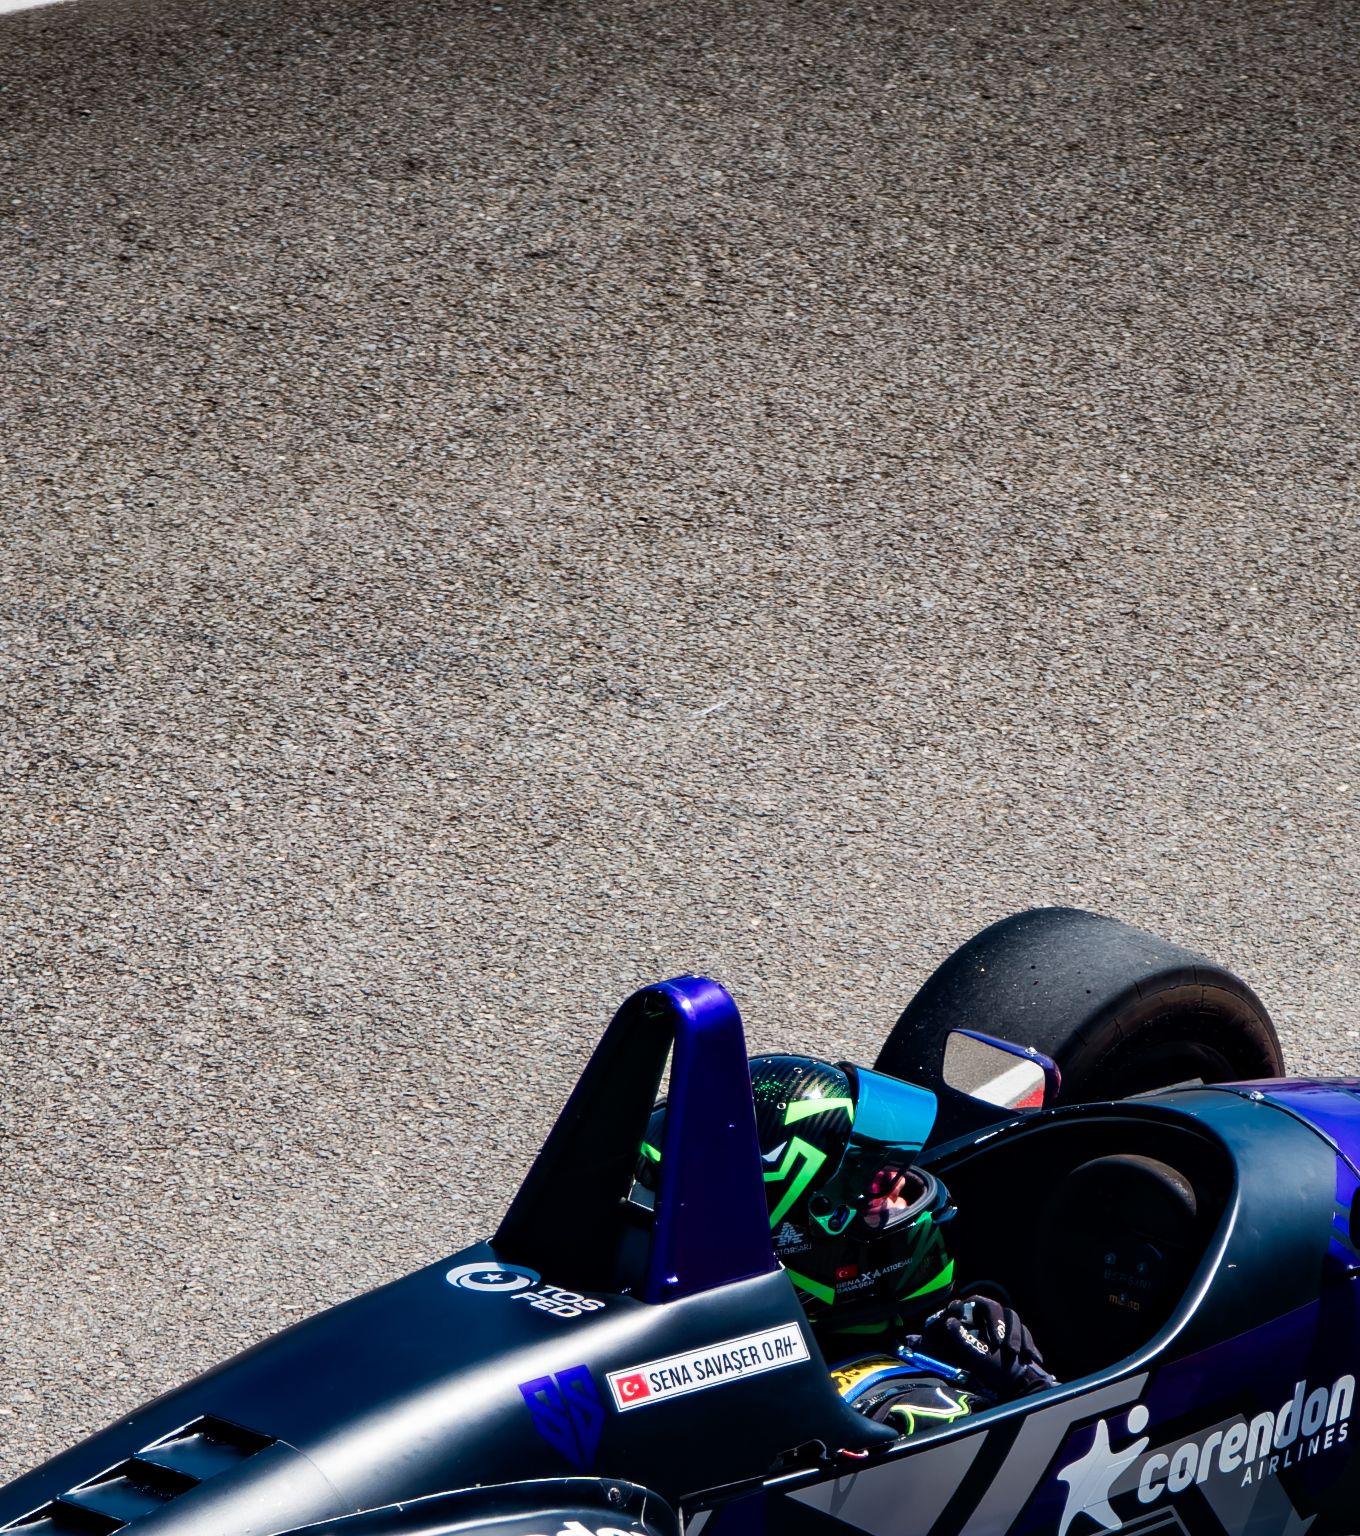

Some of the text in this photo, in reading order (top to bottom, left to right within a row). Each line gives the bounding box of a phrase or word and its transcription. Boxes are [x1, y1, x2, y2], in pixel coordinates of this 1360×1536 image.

[510, 1291, 584, 1319] FED
[535, 1284, 607, 1313] TOS
[648, 1364, 694, 1394] SENA
[694, 1346, 762, 1382] SAVAŞER
[1136, 1373, 1356, 1505] corendon
[1240, 1422, 1349, 1489] AIRLINES
